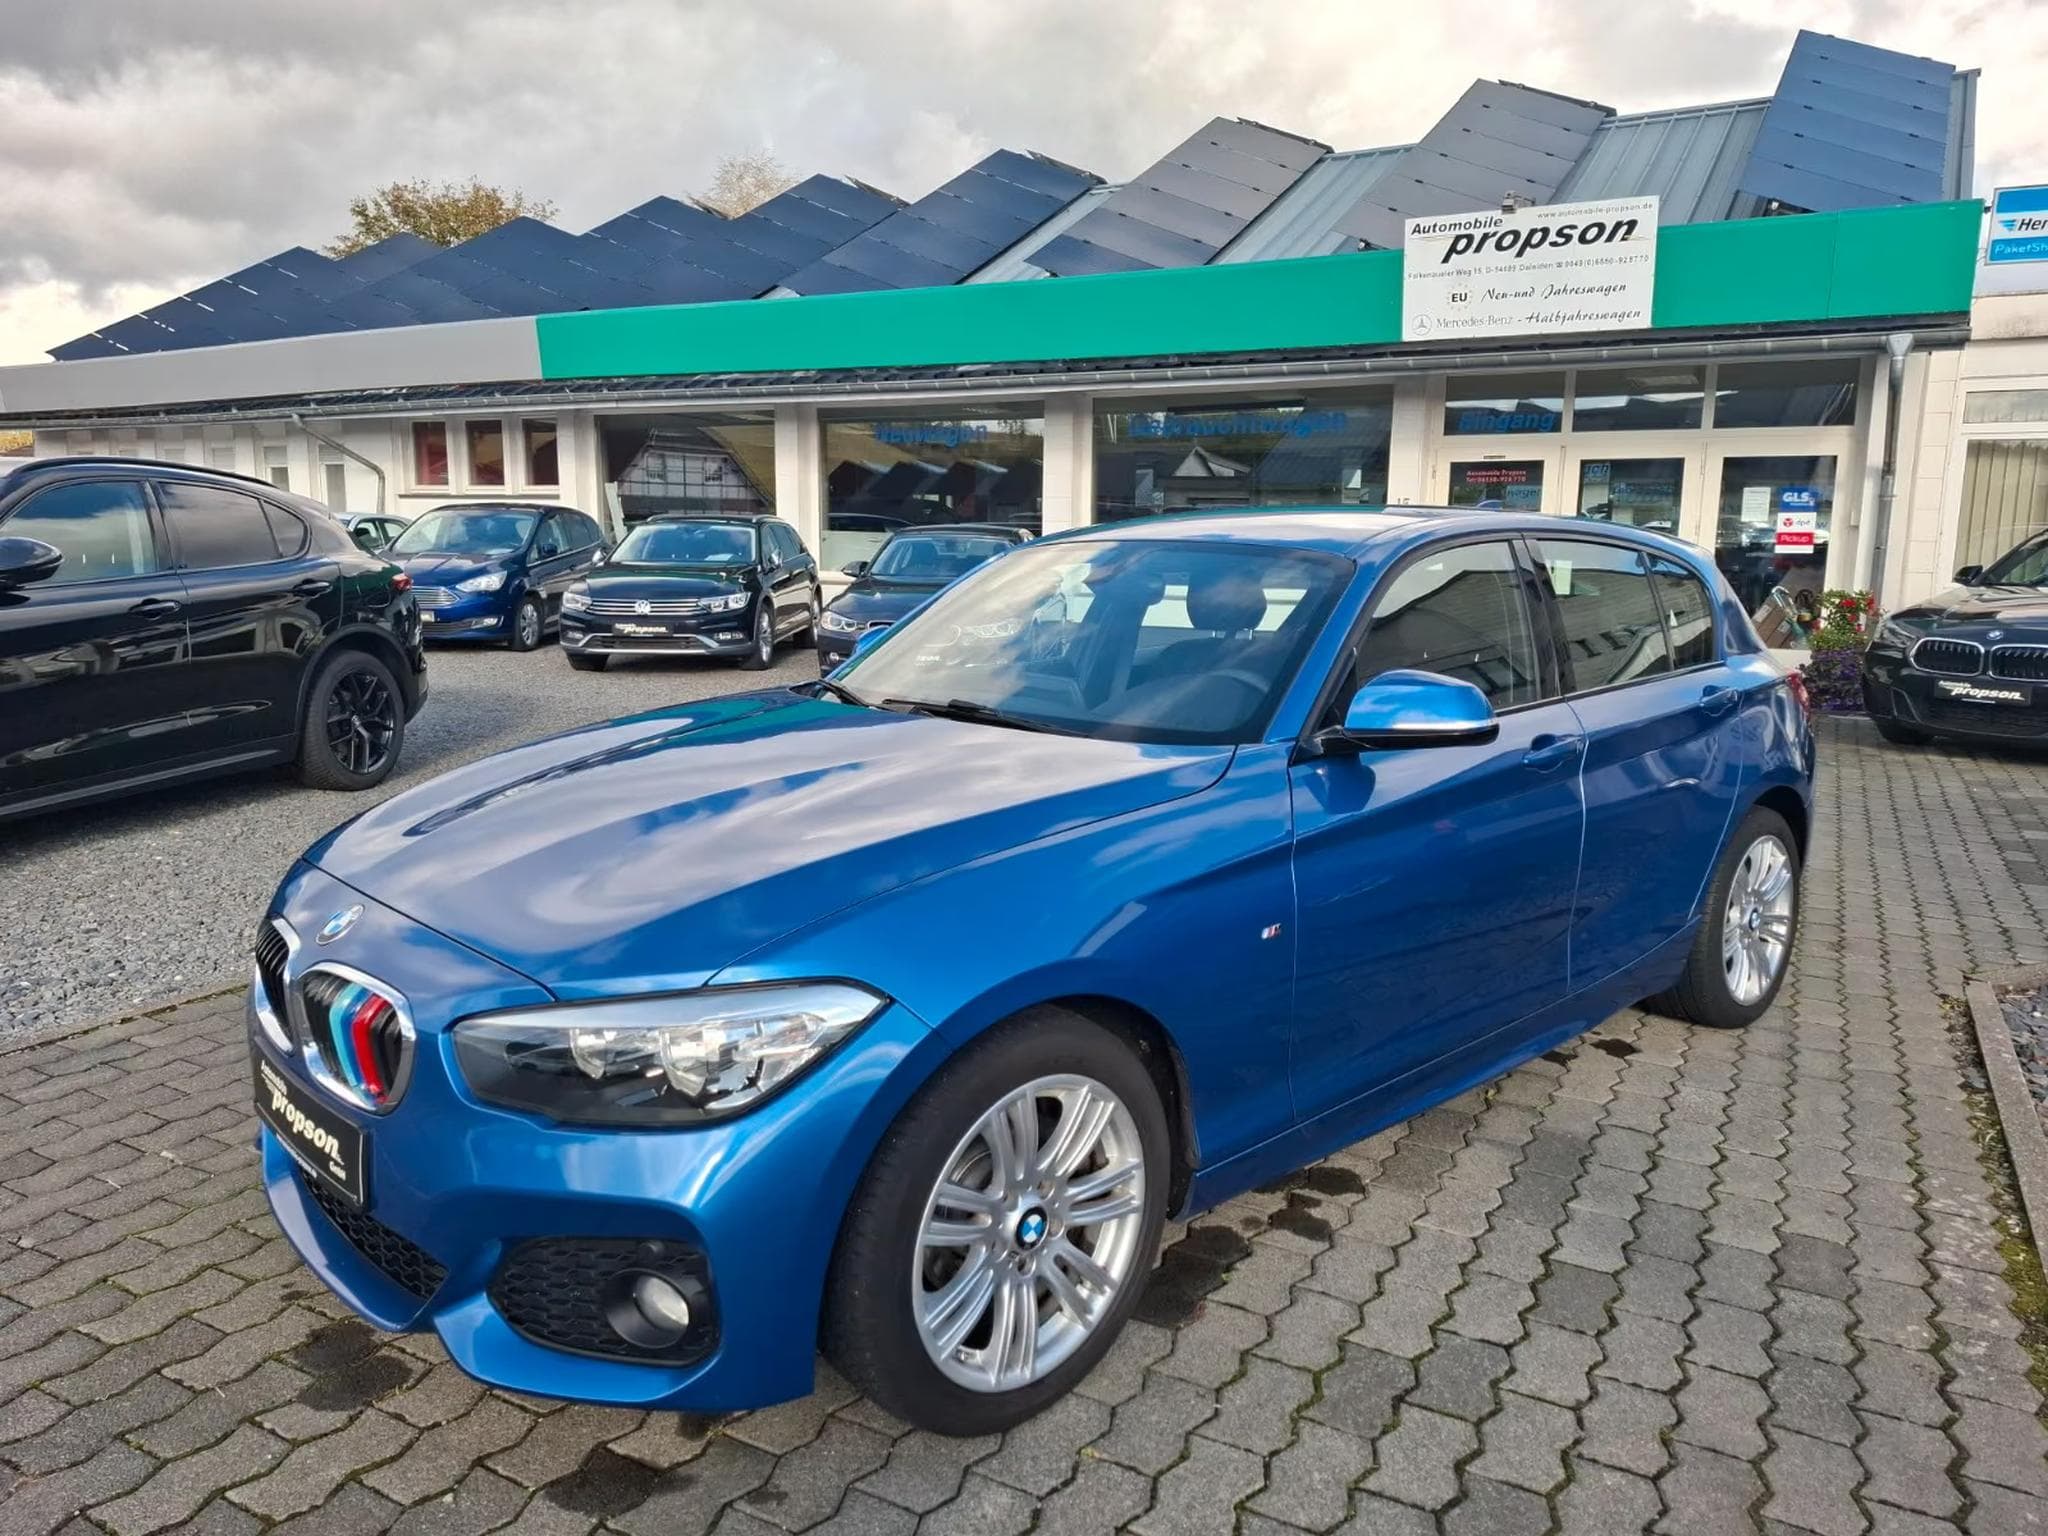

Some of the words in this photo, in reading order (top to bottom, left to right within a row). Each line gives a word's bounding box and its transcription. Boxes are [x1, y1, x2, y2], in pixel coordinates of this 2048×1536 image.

[1411, 216, 1503, 235] Automobile
[1441, 218, 1639, 264] propson
[1451, 292, 1468, 303] EU
[1541, 282, 1627, 300] Jahreswagen
[1436, 315, 1513, 329] Mercedes-Benz
[1783, 492, 1809, 502] GLS
[1780, 535, 1810, 543] Pickup
[1951, 687, 2021, 699] propson
[272, 1091, 340, 1160] propson
